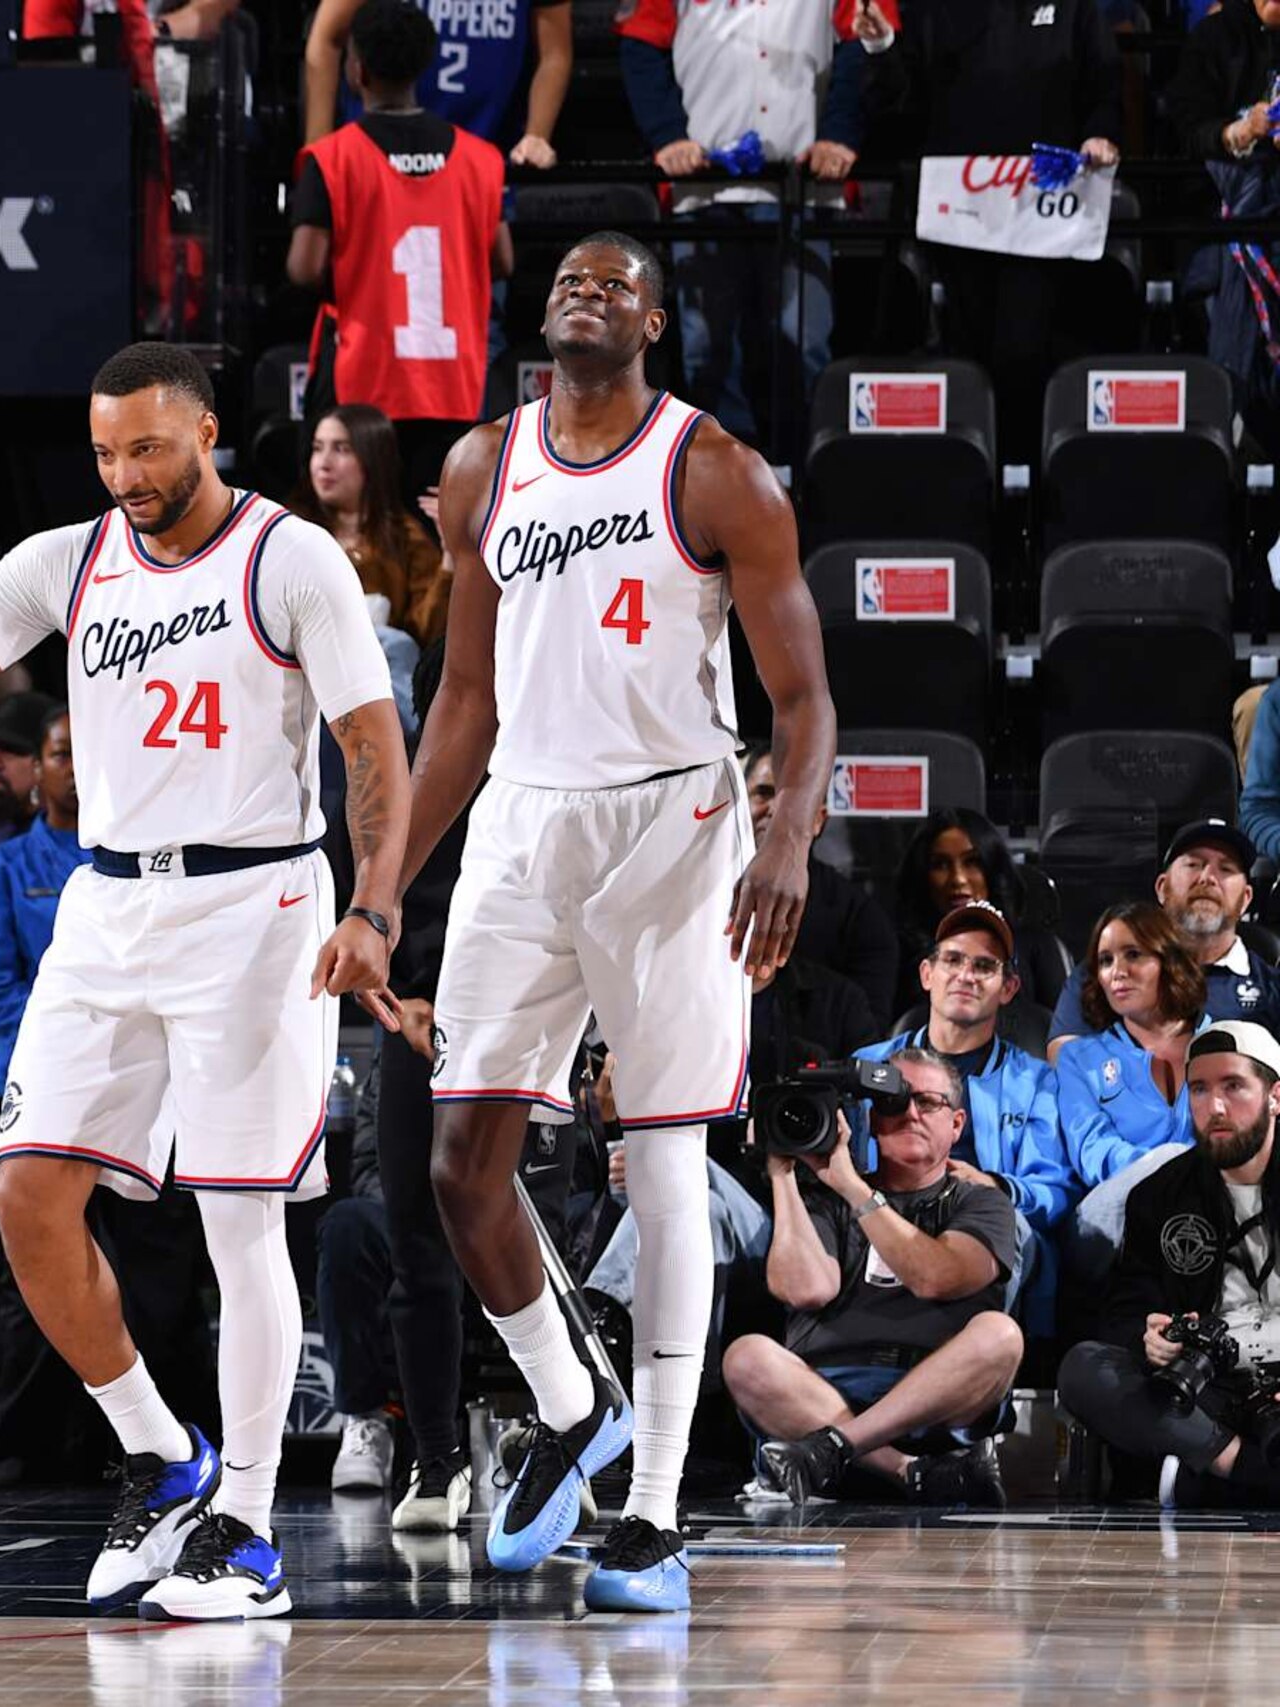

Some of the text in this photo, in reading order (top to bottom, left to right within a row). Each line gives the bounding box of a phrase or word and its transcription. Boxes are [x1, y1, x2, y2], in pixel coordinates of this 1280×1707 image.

[414, 0, 518, 38] IPPERS
[437, 41, 469, 93] 2
[1036, 191, 1078, 218] GO
[392, 225, 457, 359] 1
[497, 508, 655, 582] Clippers
[82, 598, 232, 680] Clippers
[601, 577, 651, 645] 4
[142, 680, 228, 749] 24
[148, 851, 173, 873] LA
